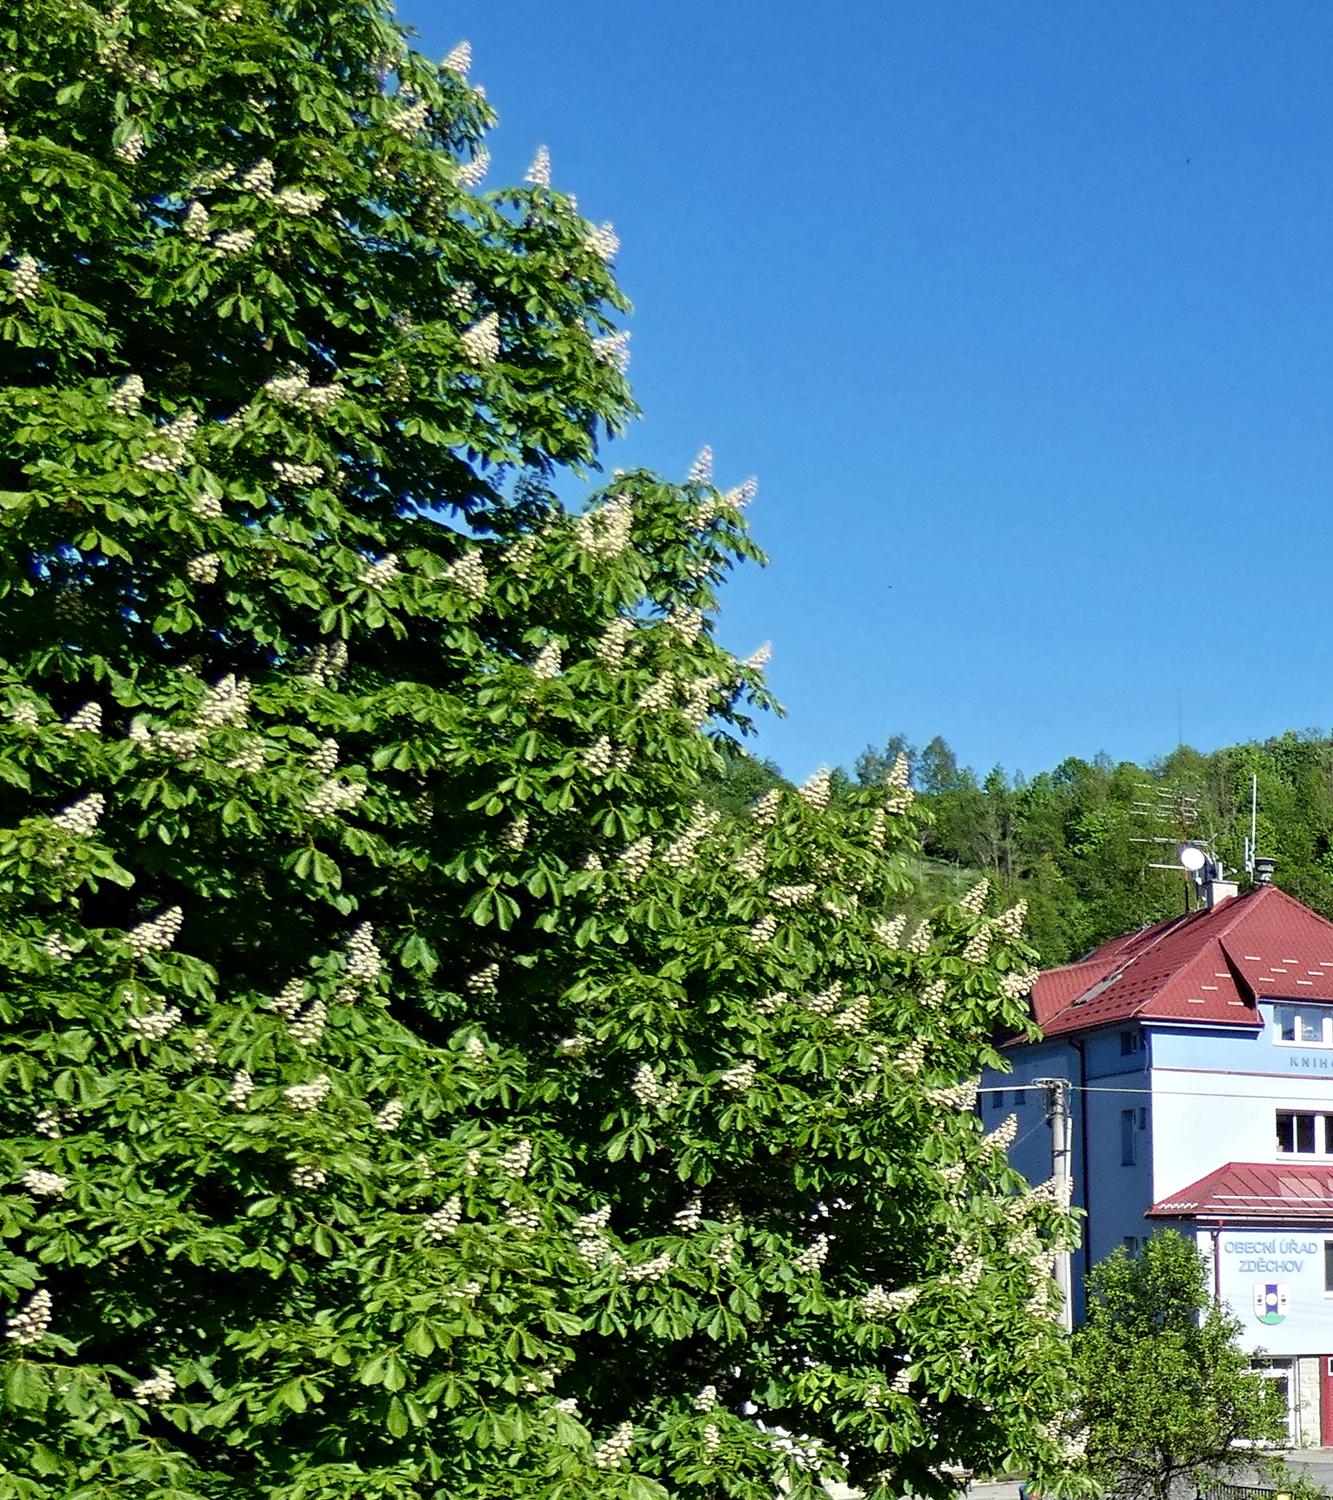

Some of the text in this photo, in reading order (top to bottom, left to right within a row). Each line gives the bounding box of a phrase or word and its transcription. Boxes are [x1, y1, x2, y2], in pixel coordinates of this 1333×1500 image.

[1224, 1238, 1318, 1254] OBECNÍ ÚŘAD
[1238, 1256, 1304, 1272] ZDĚCHOV
